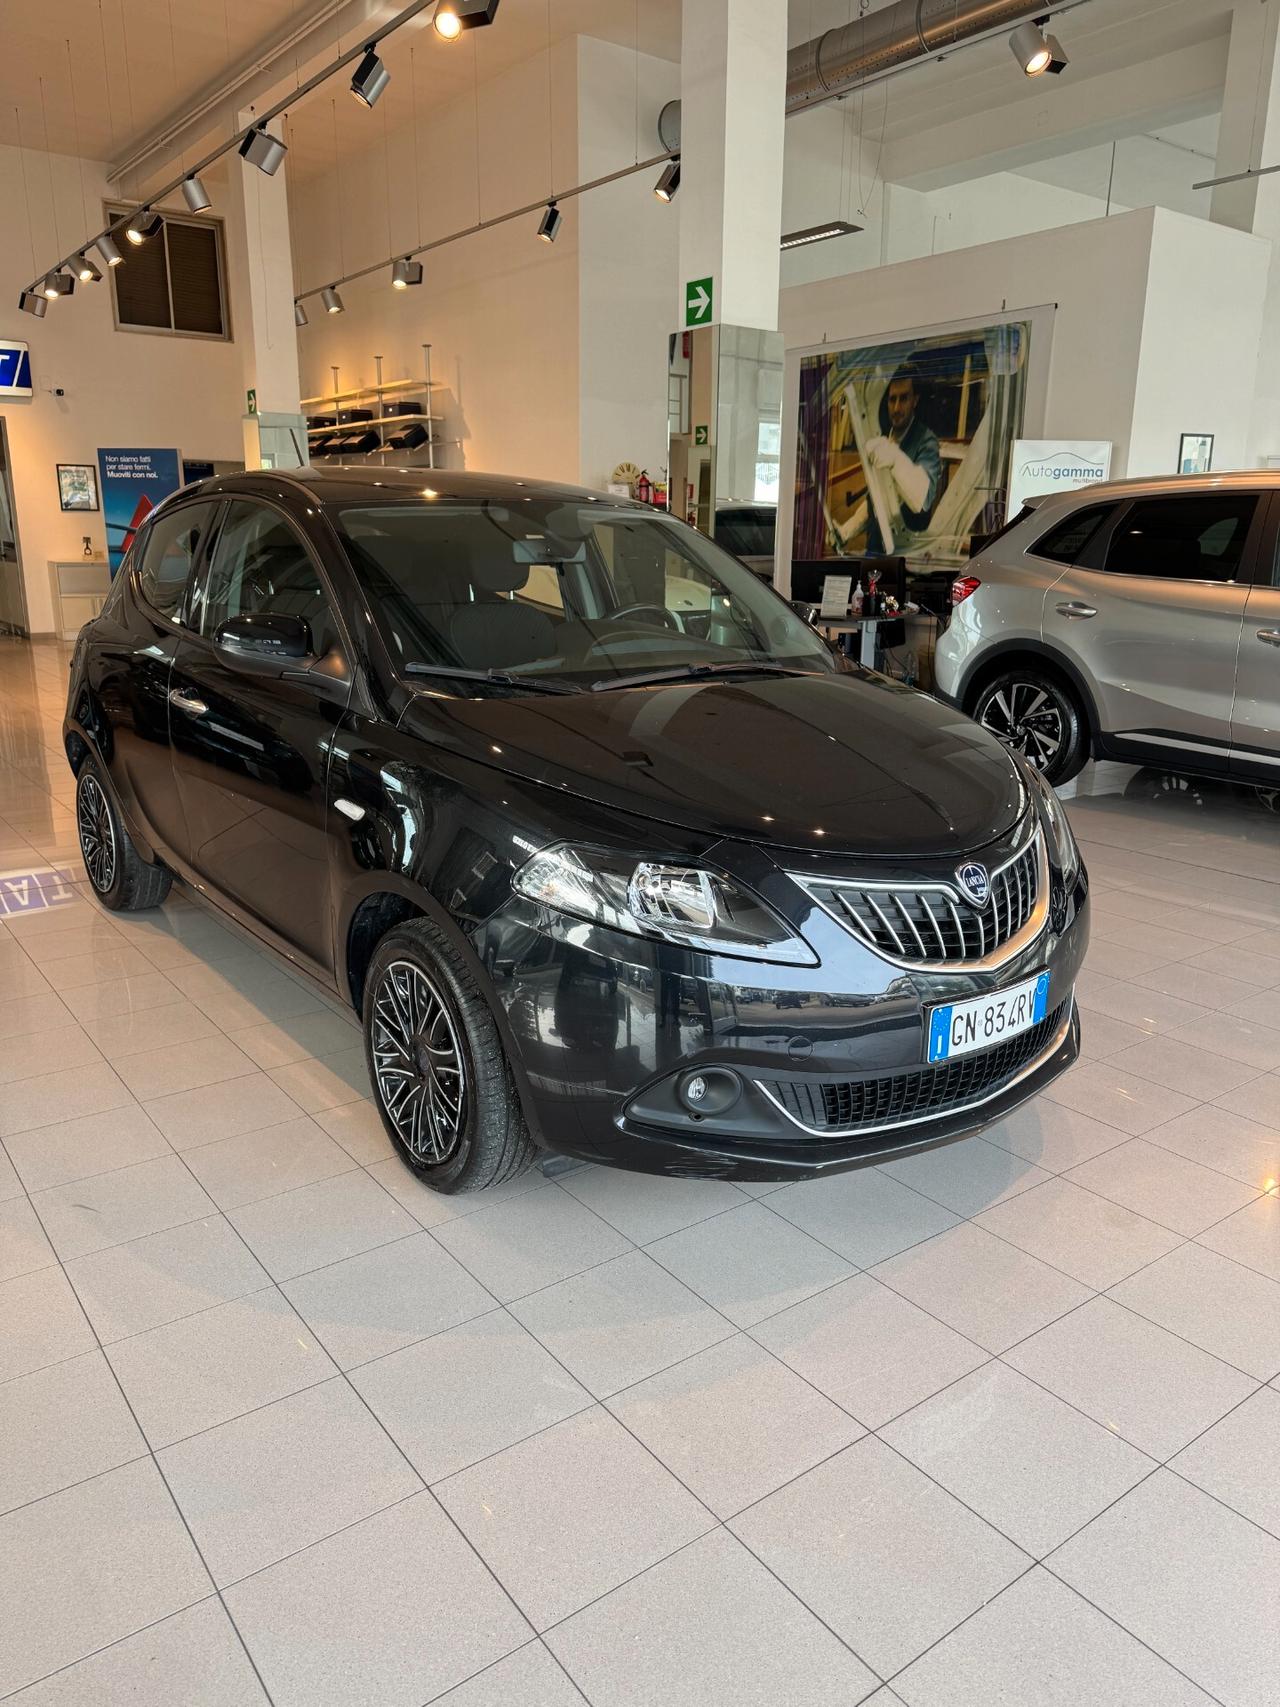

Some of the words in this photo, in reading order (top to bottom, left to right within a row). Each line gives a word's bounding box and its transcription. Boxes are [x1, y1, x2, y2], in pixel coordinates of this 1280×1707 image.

[105, 455, 119, 463] Non
[119, 455, 139, 463] siamo
[139, 455, 152, 463] fatti
[106, 464, 117, 472] per
[118, 463, 133, 471] stare
[107, 470, 131, 479] Muoviti
[146, 471, 159, 479] noi.
[1022, 465, 1104, 480] Autogamma
[951, 1010, 978, 1046] GN
[984, 988, 1037, 1038] 834RV
